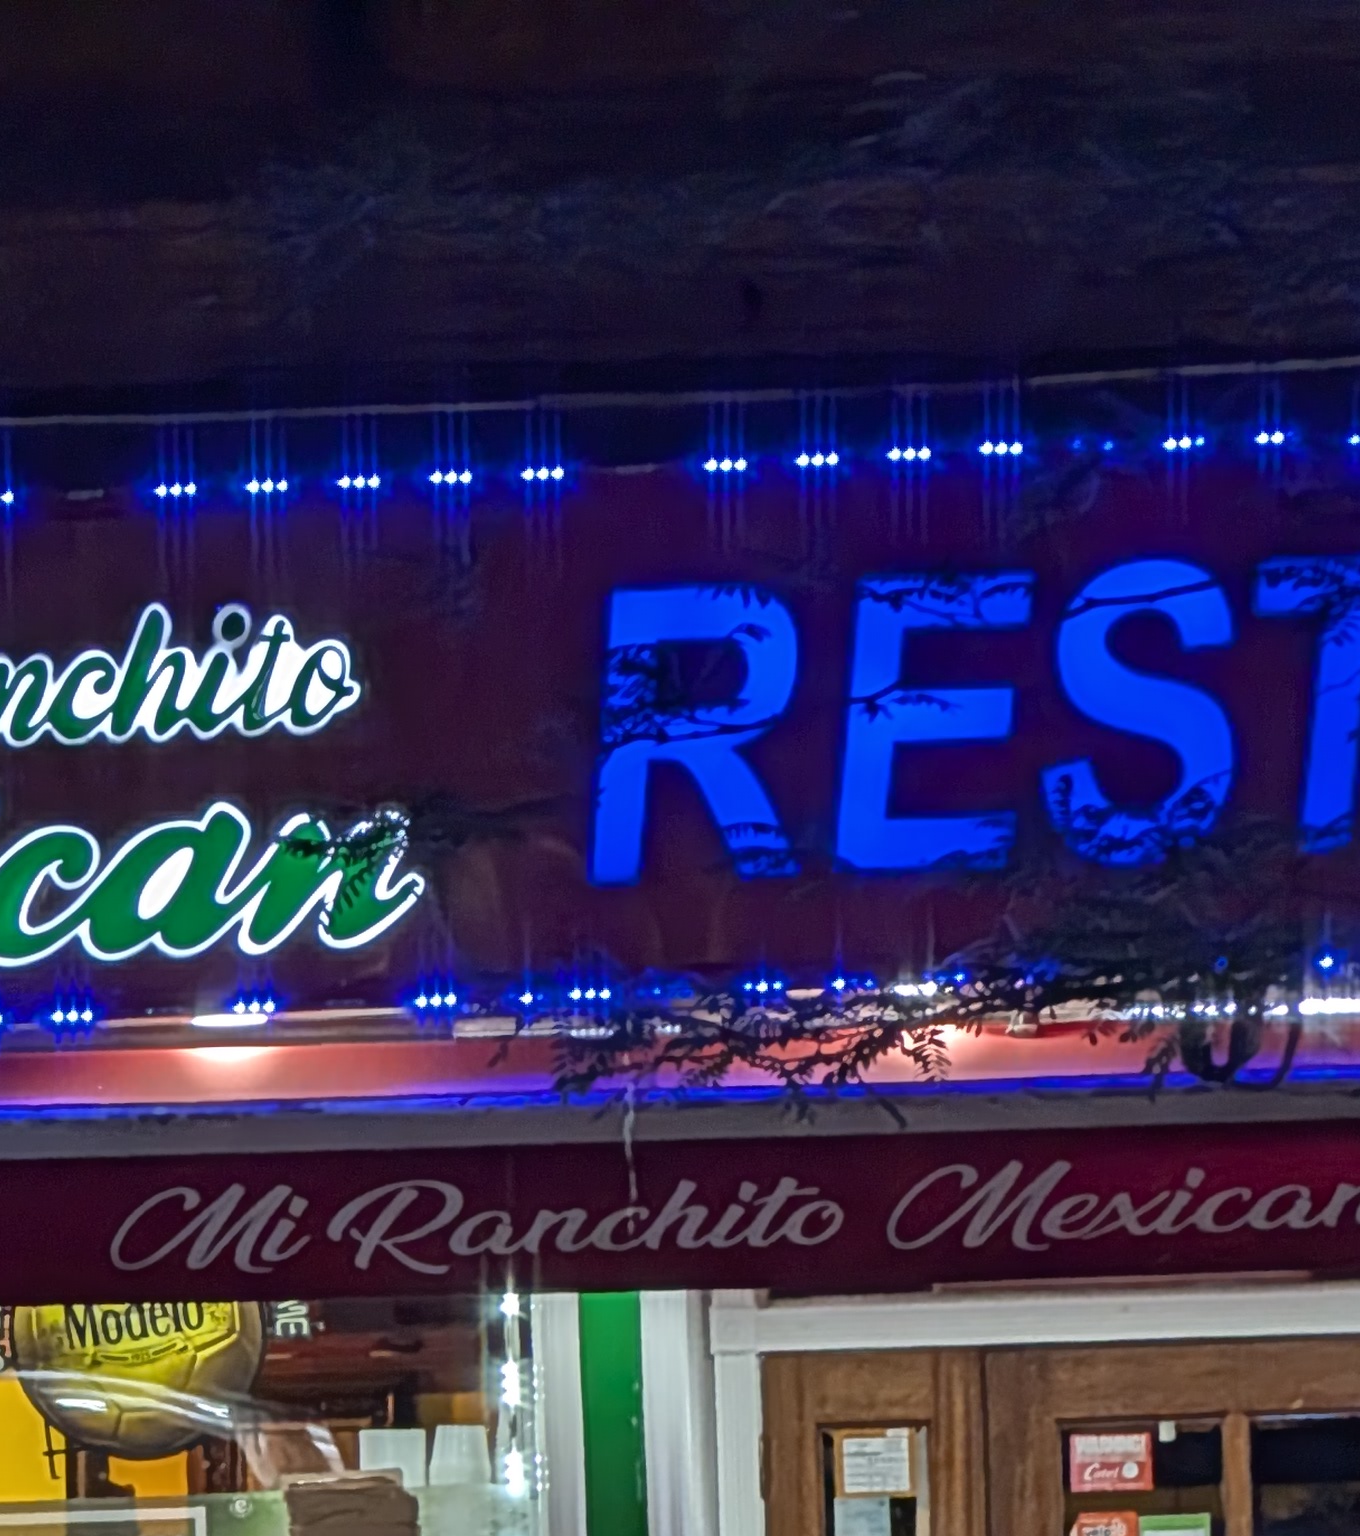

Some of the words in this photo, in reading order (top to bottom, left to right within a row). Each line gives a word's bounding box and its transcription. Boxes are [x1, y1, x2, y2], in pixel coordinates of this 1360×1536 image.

[108, 1182, 311, 1275] Mi
[326, 1177, 845, 1275] Ranchito
[63, 1301, 205, 1351] Modelo
